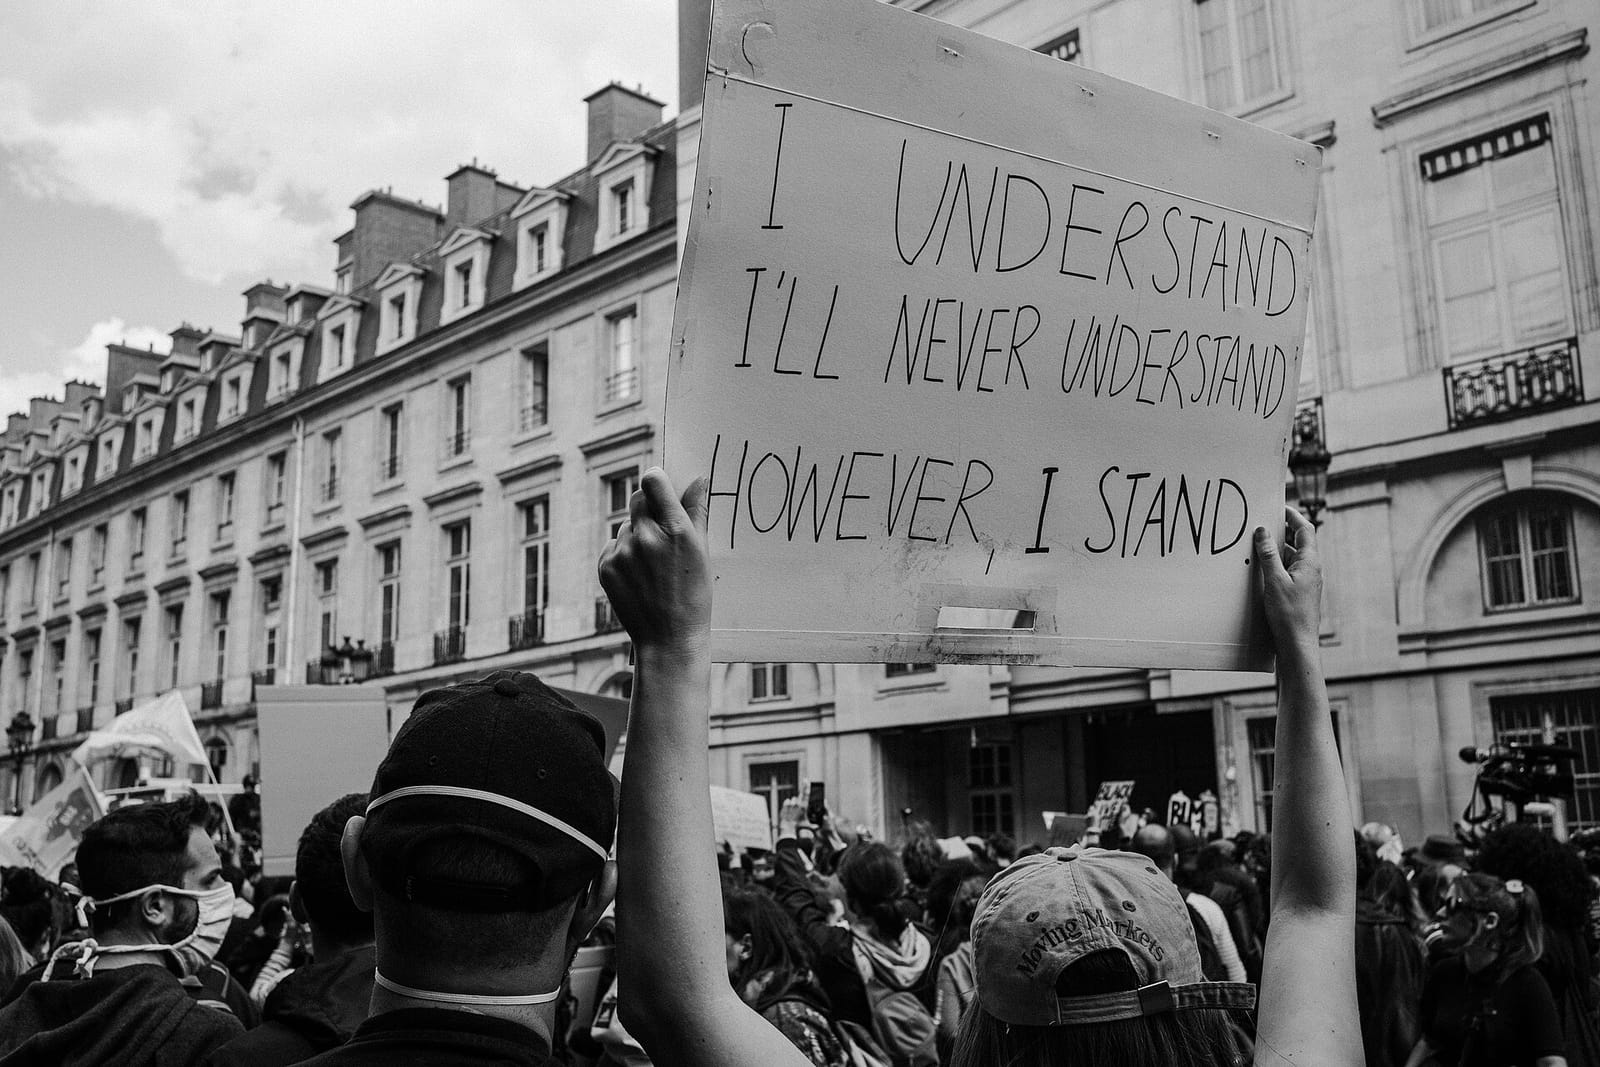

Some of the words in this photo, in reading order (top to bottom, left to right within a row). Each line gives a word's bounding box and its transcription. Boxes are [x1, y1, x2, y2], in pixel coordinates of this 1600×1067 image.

[761, 104, 793, 230] I
[895, 139, 1297, 317] UNDERSTAND
[734, 267, 839, 379] I'LL
[884, 294, 1042, 393] NEVER
[1060, 314, 1287, 420] UNDERSTAND
[707, 434, 996, 576] HOWEVER,
[1024, 466, 1060, 555] I
[1084, 465, 1252, 566] STAND.
[1016, 918, 1083, 980] Moving
